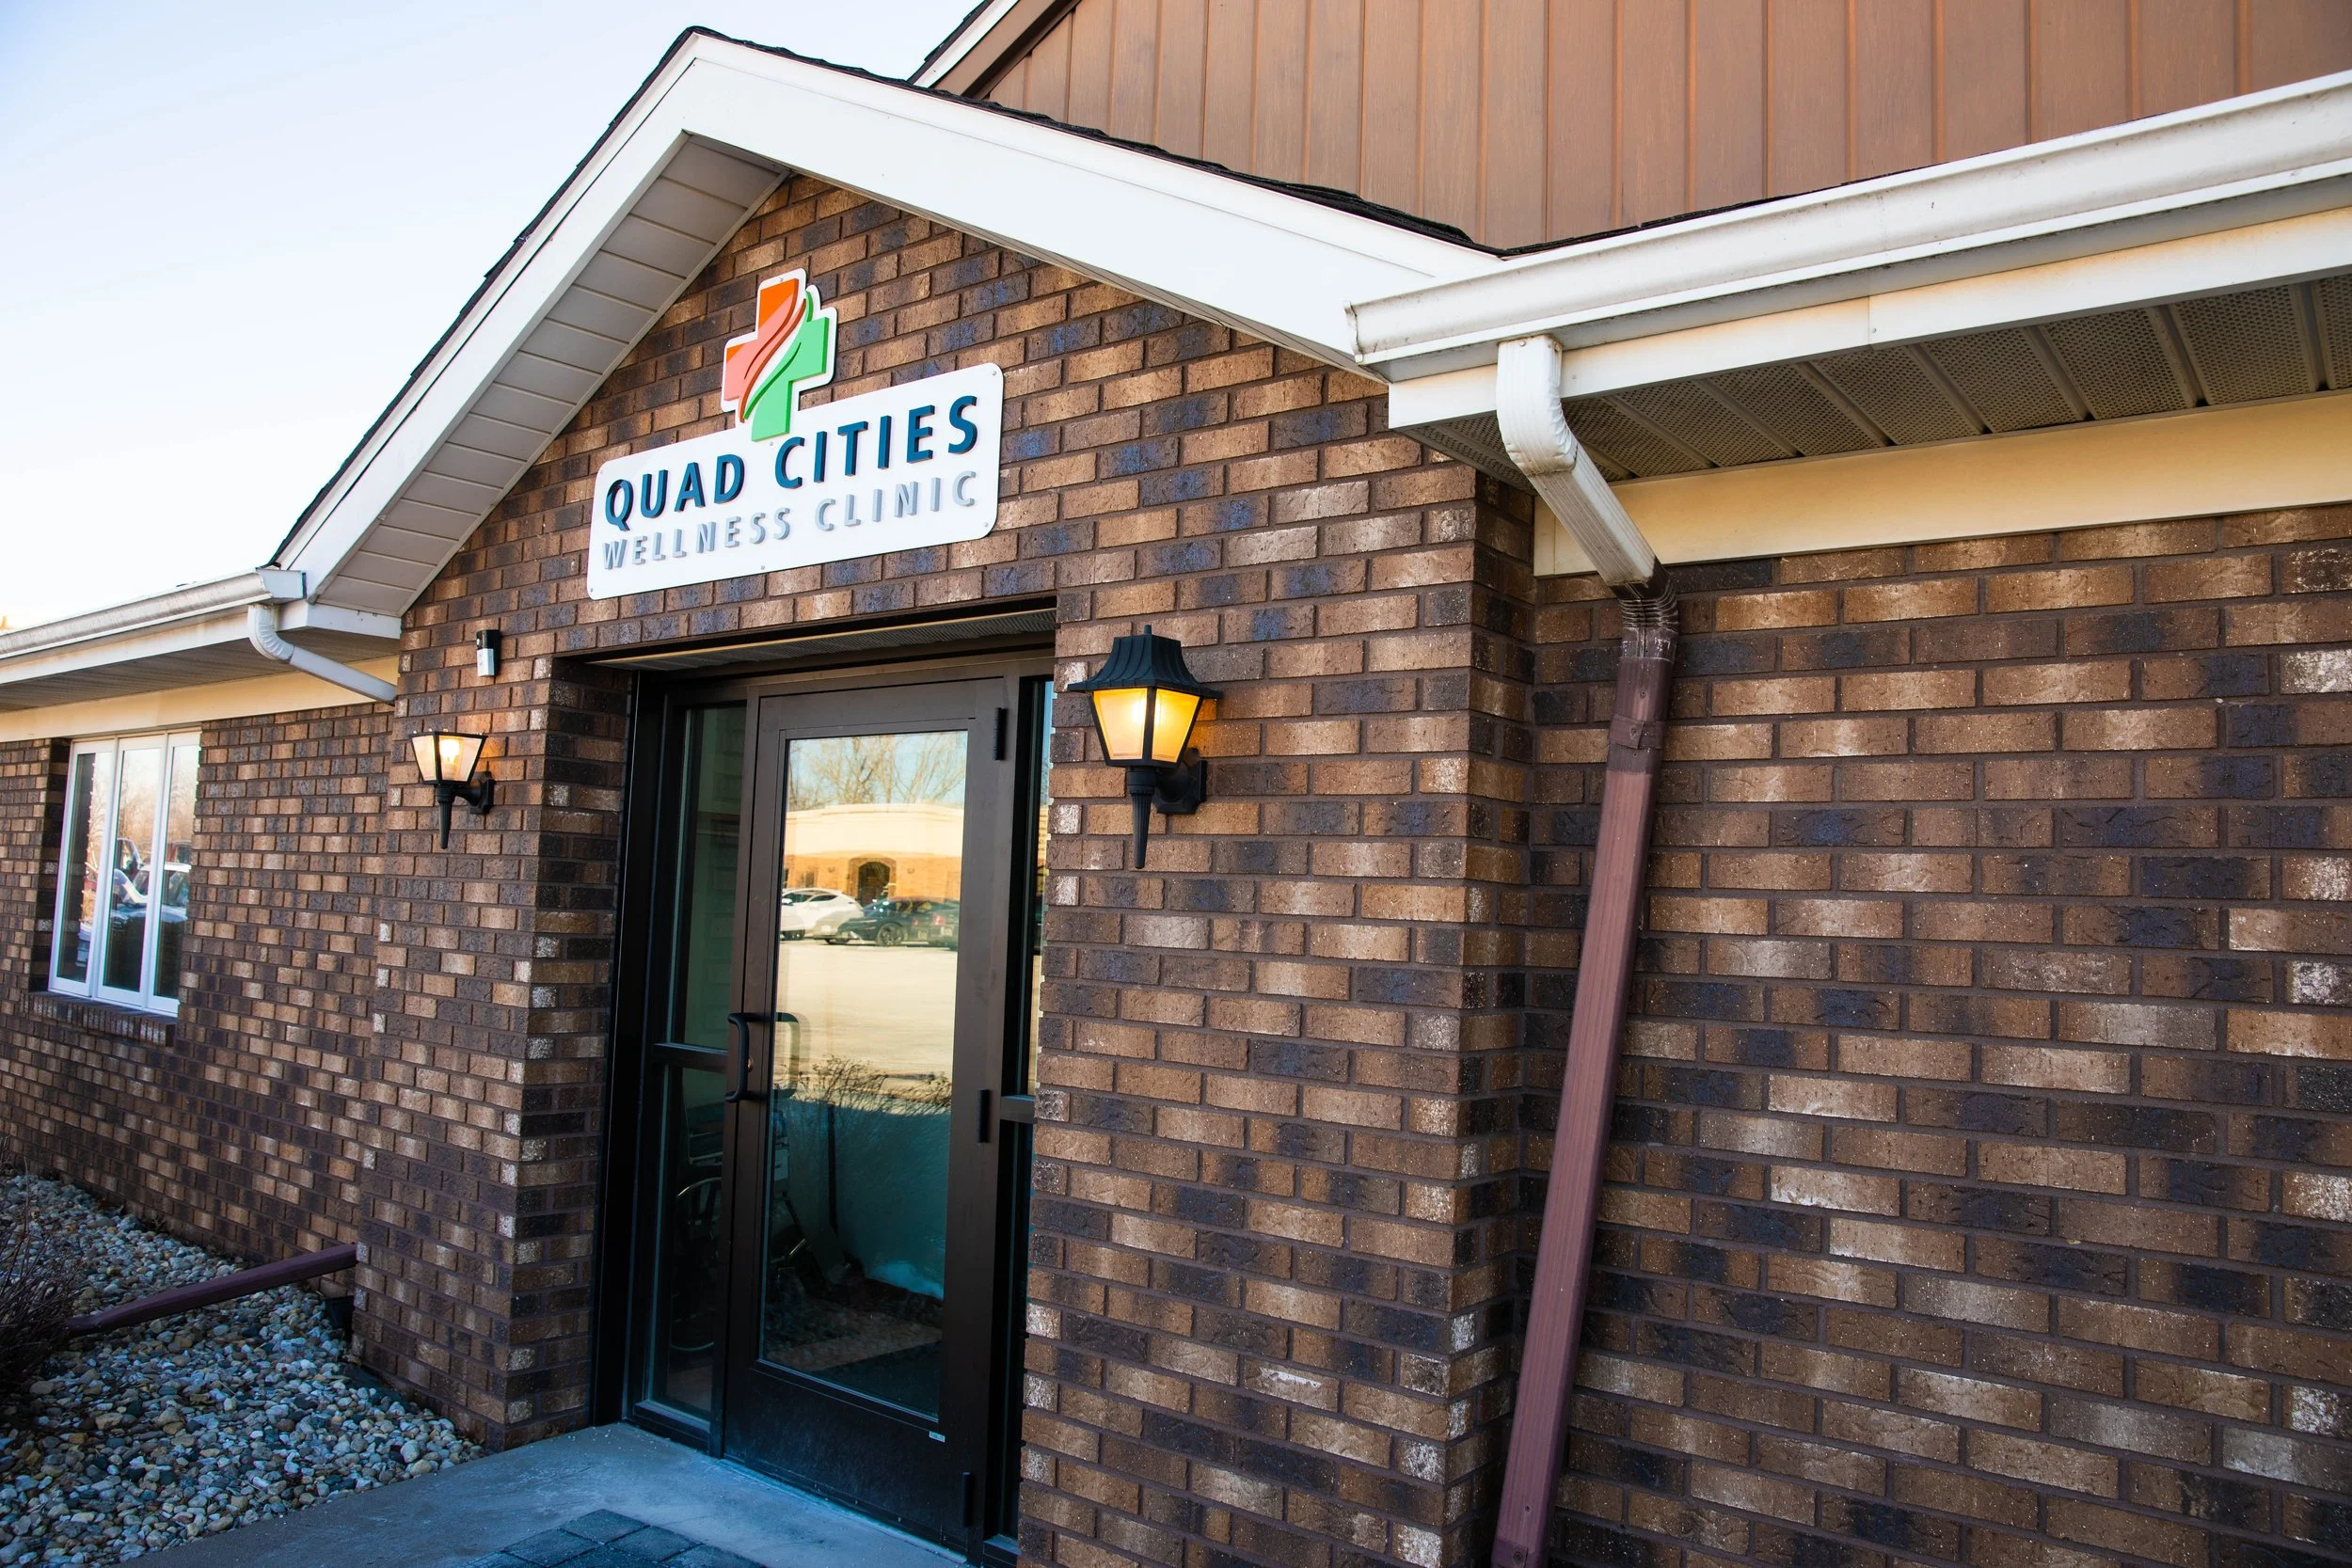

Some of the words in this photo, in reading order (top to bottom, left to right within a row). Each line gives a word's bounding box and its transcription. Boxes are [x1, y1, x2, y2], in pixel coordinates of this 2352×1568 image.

[602, 507, 791, 571] WELLNESS
[815, 470, 977, 531] CLINIC
[604, 453, 746, 531] QUAD
[774, 395, 978, 489] CITIES
